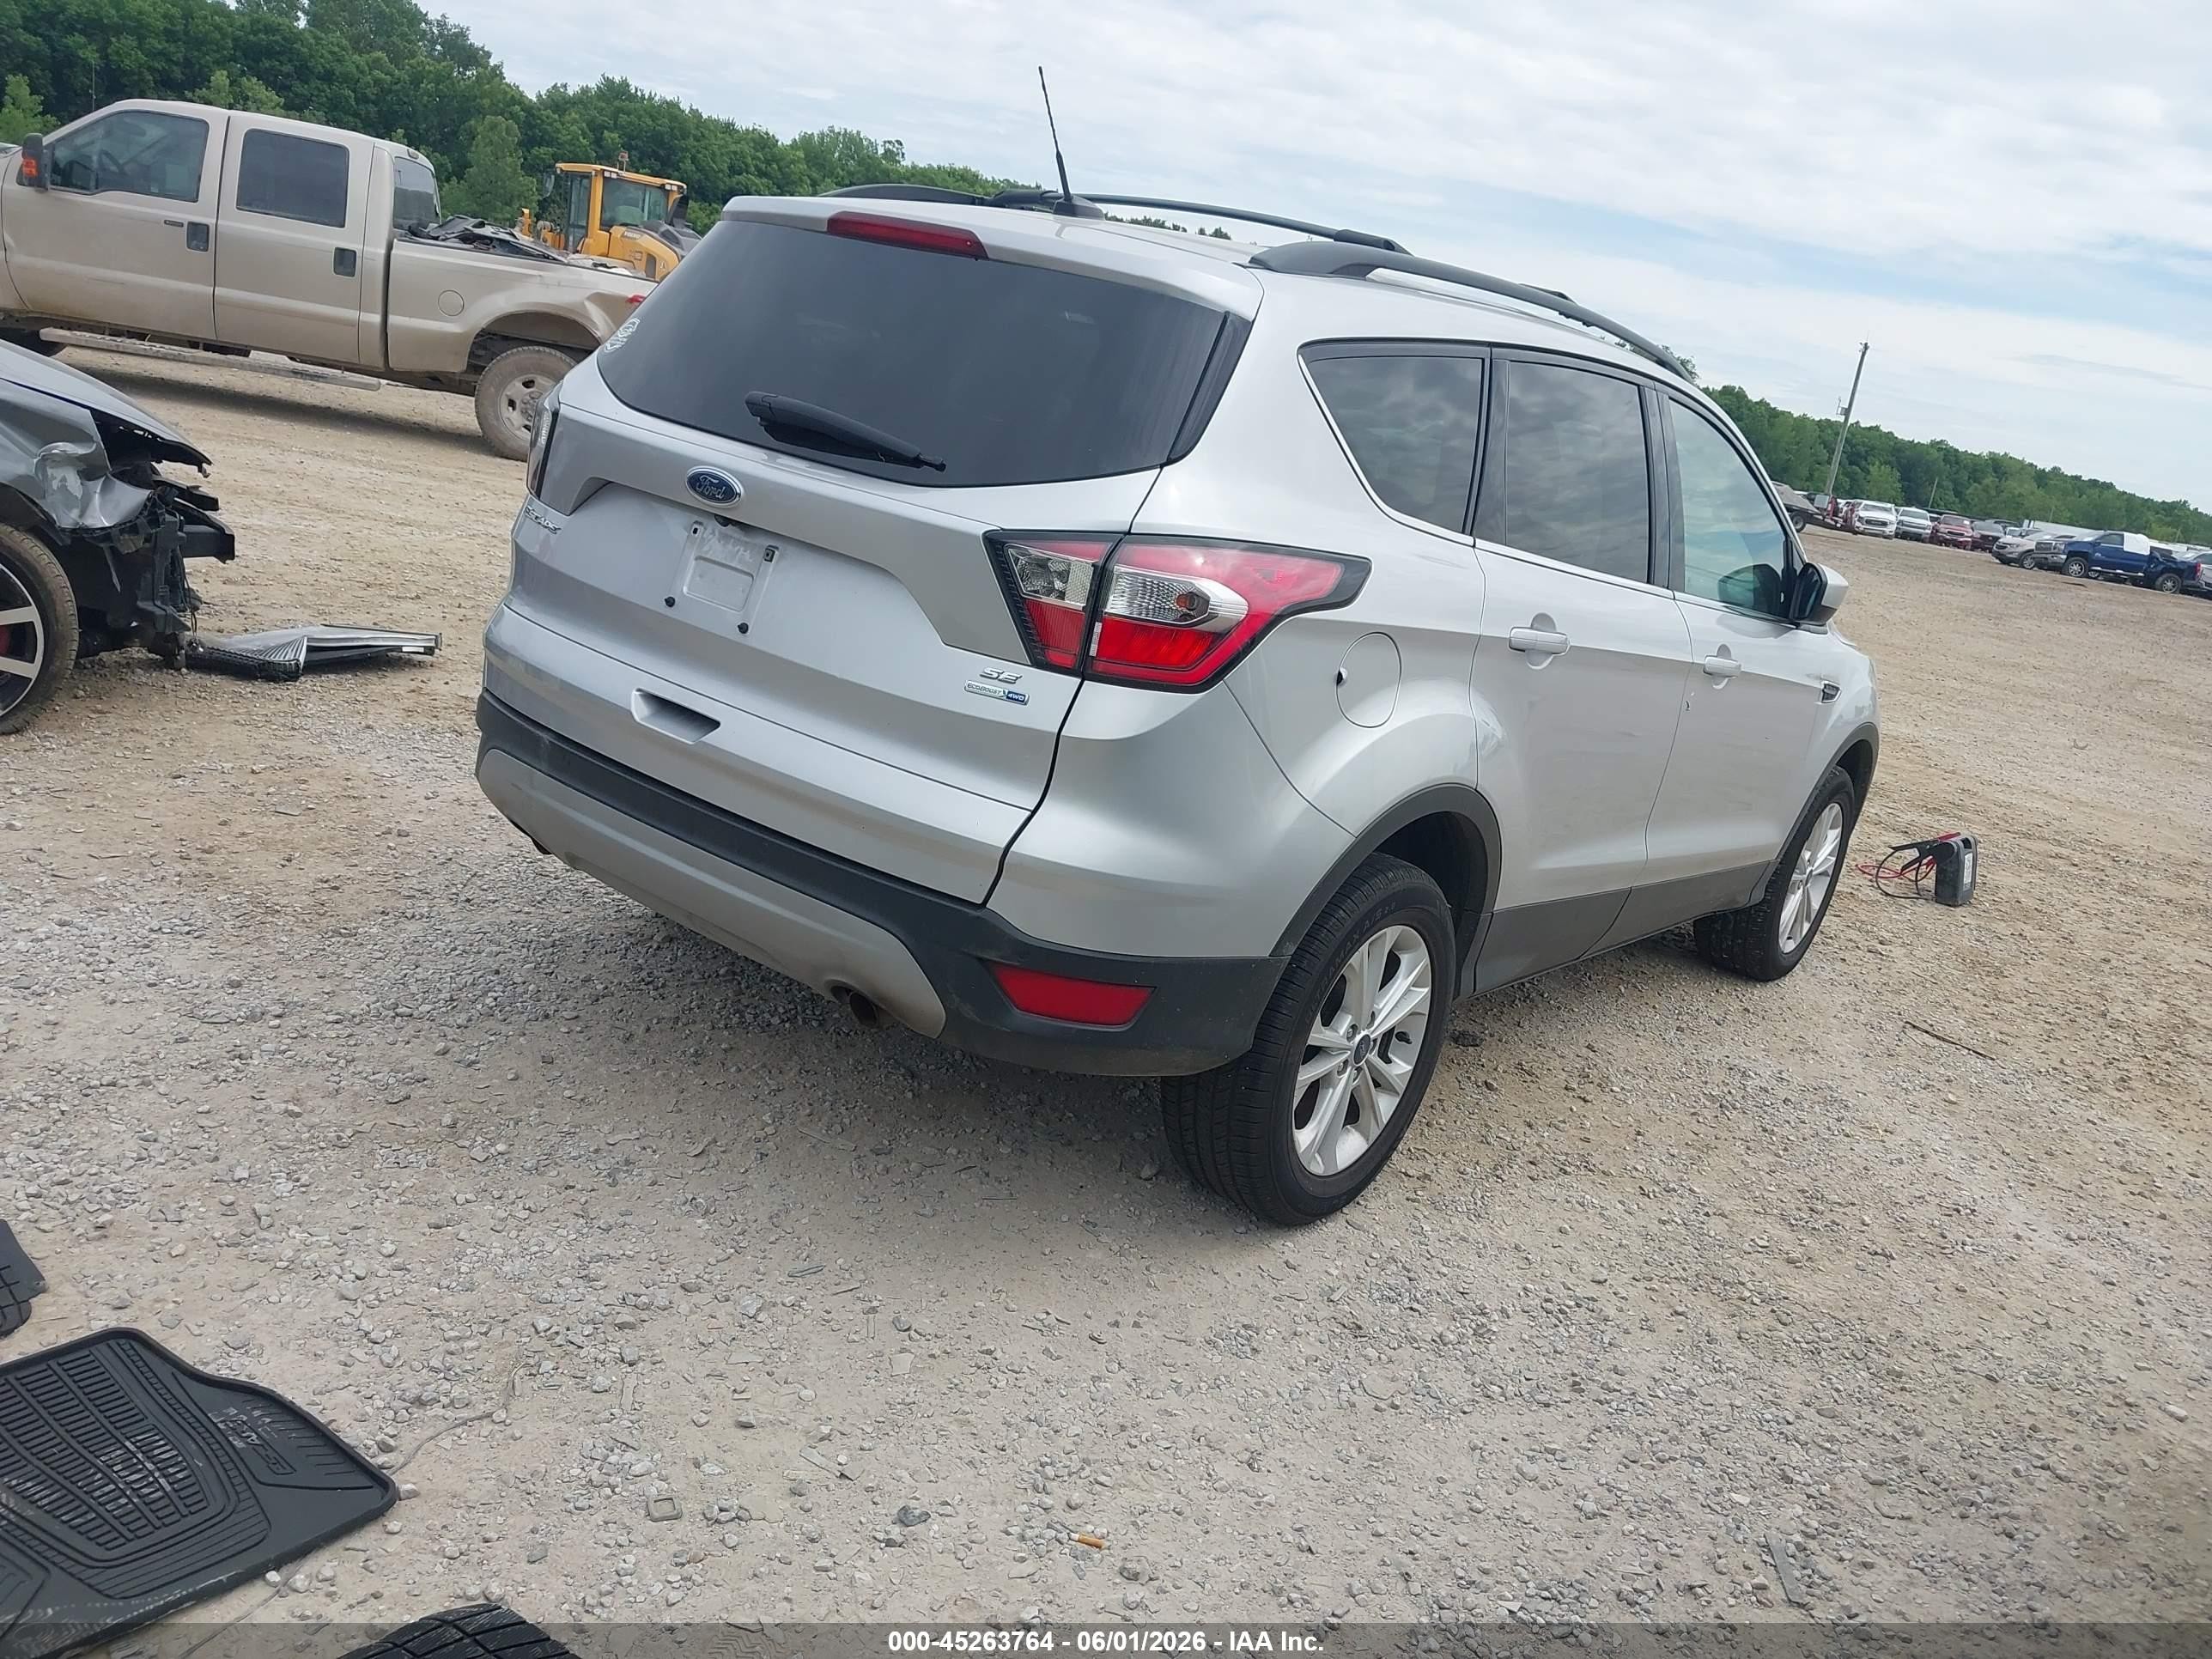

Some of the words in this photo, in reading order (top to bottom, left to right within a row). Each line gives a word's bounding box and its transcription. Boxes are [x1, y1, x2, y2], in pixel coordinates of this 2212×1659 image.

[696, 474, 725, 499] Ford
[979, 666, 1023, 684] SE
[1007, 692, 1025, 702] 4WD
